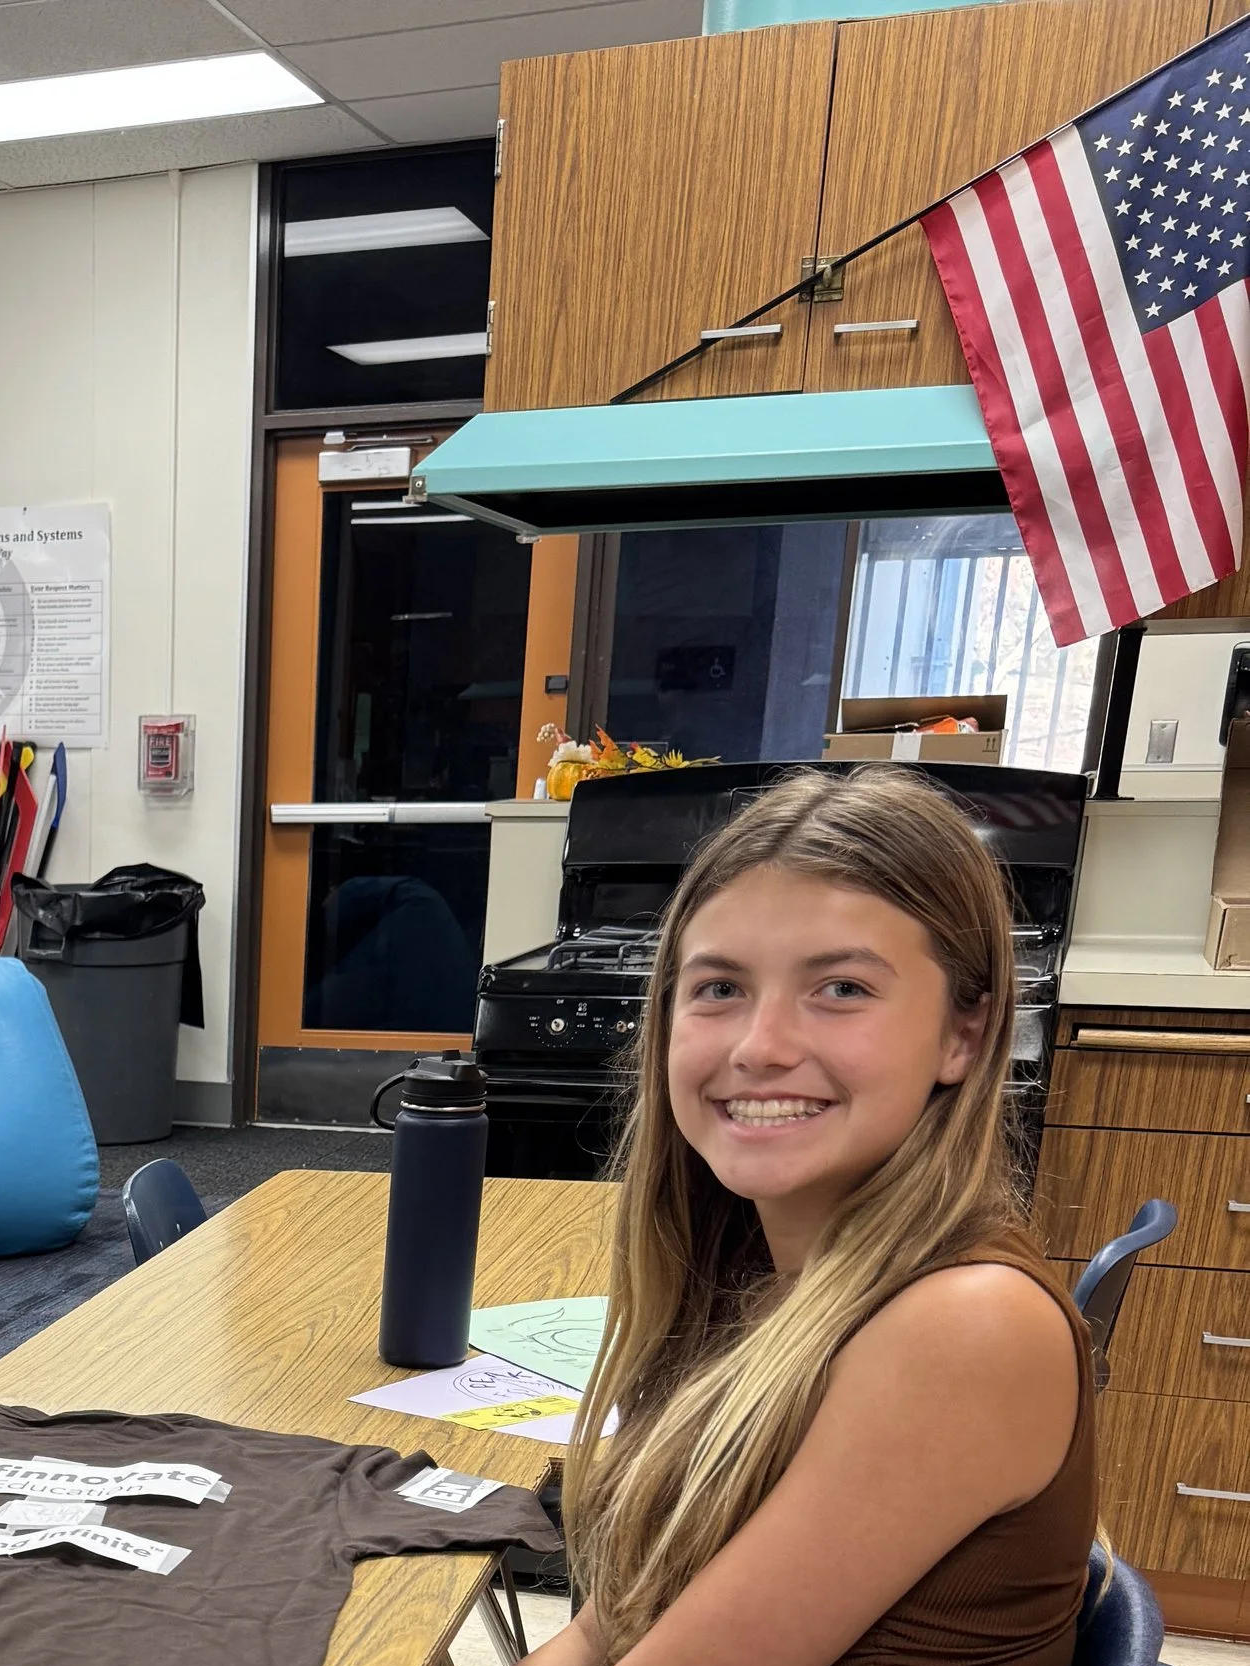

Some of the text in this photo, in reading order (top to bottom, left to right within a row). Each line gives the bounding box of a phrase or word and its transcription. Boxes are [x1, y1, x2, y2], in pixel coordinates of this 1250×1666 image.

[12, 530, 34, 543] and
[36, 529, 83, 545] Systems
[150, 736, 171, 747] FIRE
